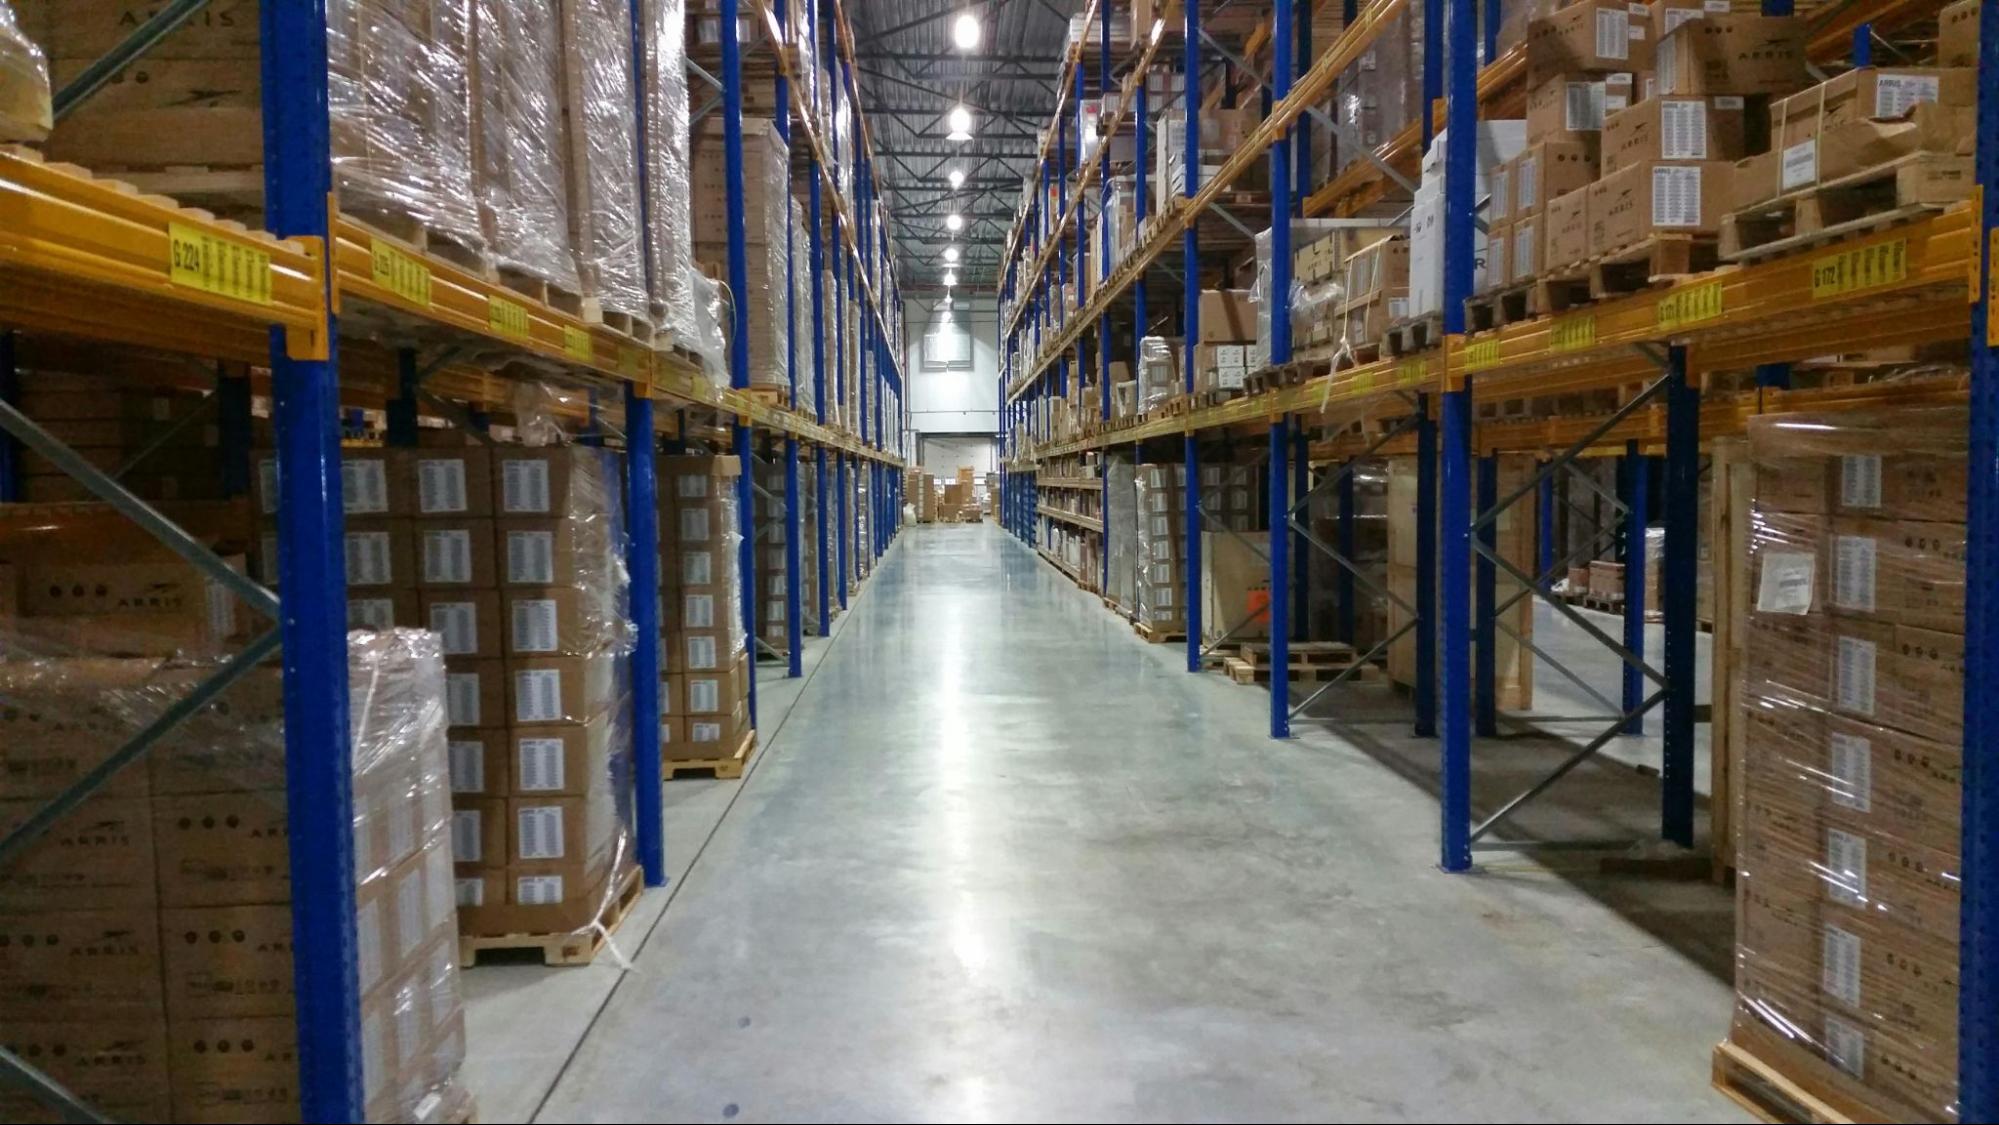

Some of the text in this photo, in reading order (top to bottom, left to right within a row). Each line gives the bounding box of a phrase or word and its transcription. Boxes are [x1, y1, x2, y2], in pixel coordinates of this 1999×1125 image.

[118, 10, 235, 27] AIS
[1738, 50, 1793, 61] ARRIS
[1879, 78, 1902, 88] ARRIS
[173, 239, 200, 272] G 224
[1815, 266, 1836, 288] G 172
[118, 597, 182, 607] ARRIS
[60, 835, 130, 847] ARRIS
[70, 944, 140, 956] ARRIS
[75, 1054, 146, 1066] ARRIS
